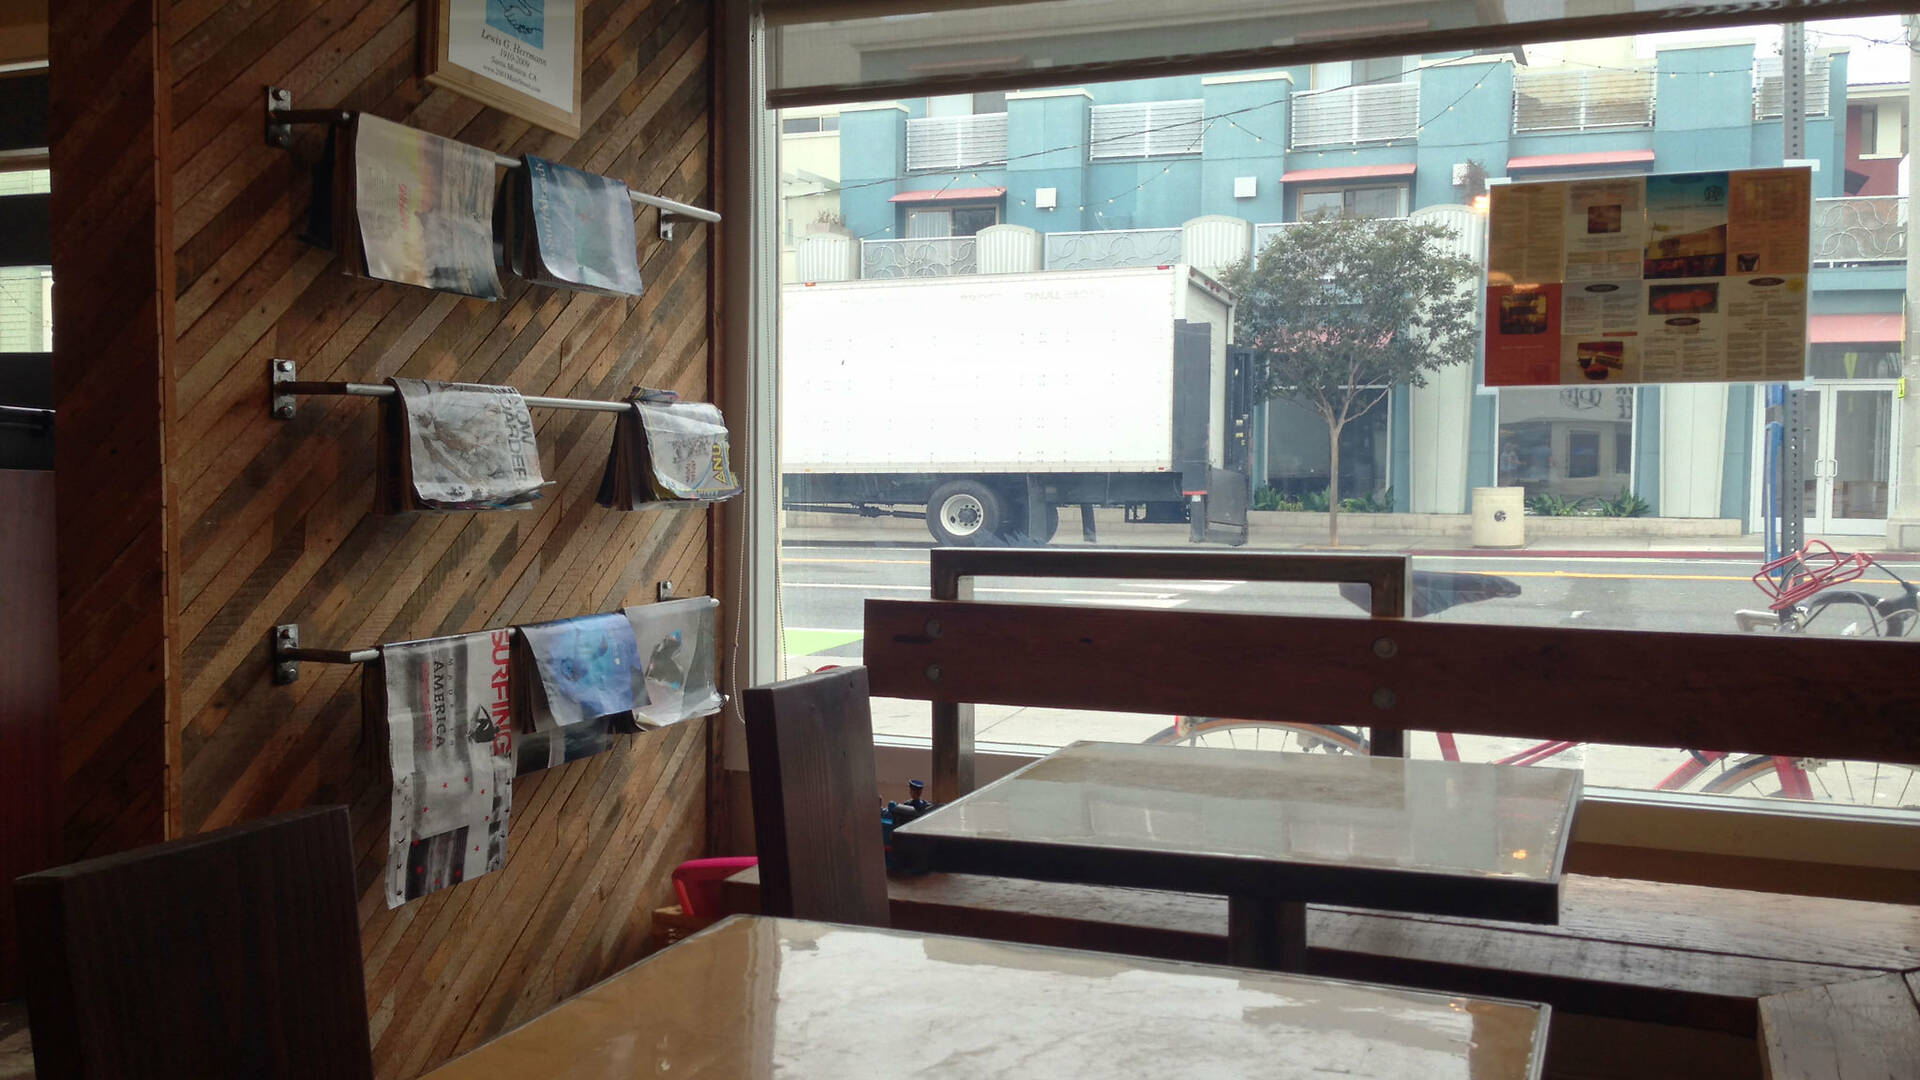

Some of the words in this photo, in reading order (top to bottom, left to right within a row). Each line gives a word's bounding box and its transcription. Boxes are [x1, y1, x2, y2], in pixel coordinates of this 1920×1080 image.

[481, 29, 502, 46] Lewis
[433, 660, 447, 749] AMERICA
[491, 631, 512, 756] SURFING
